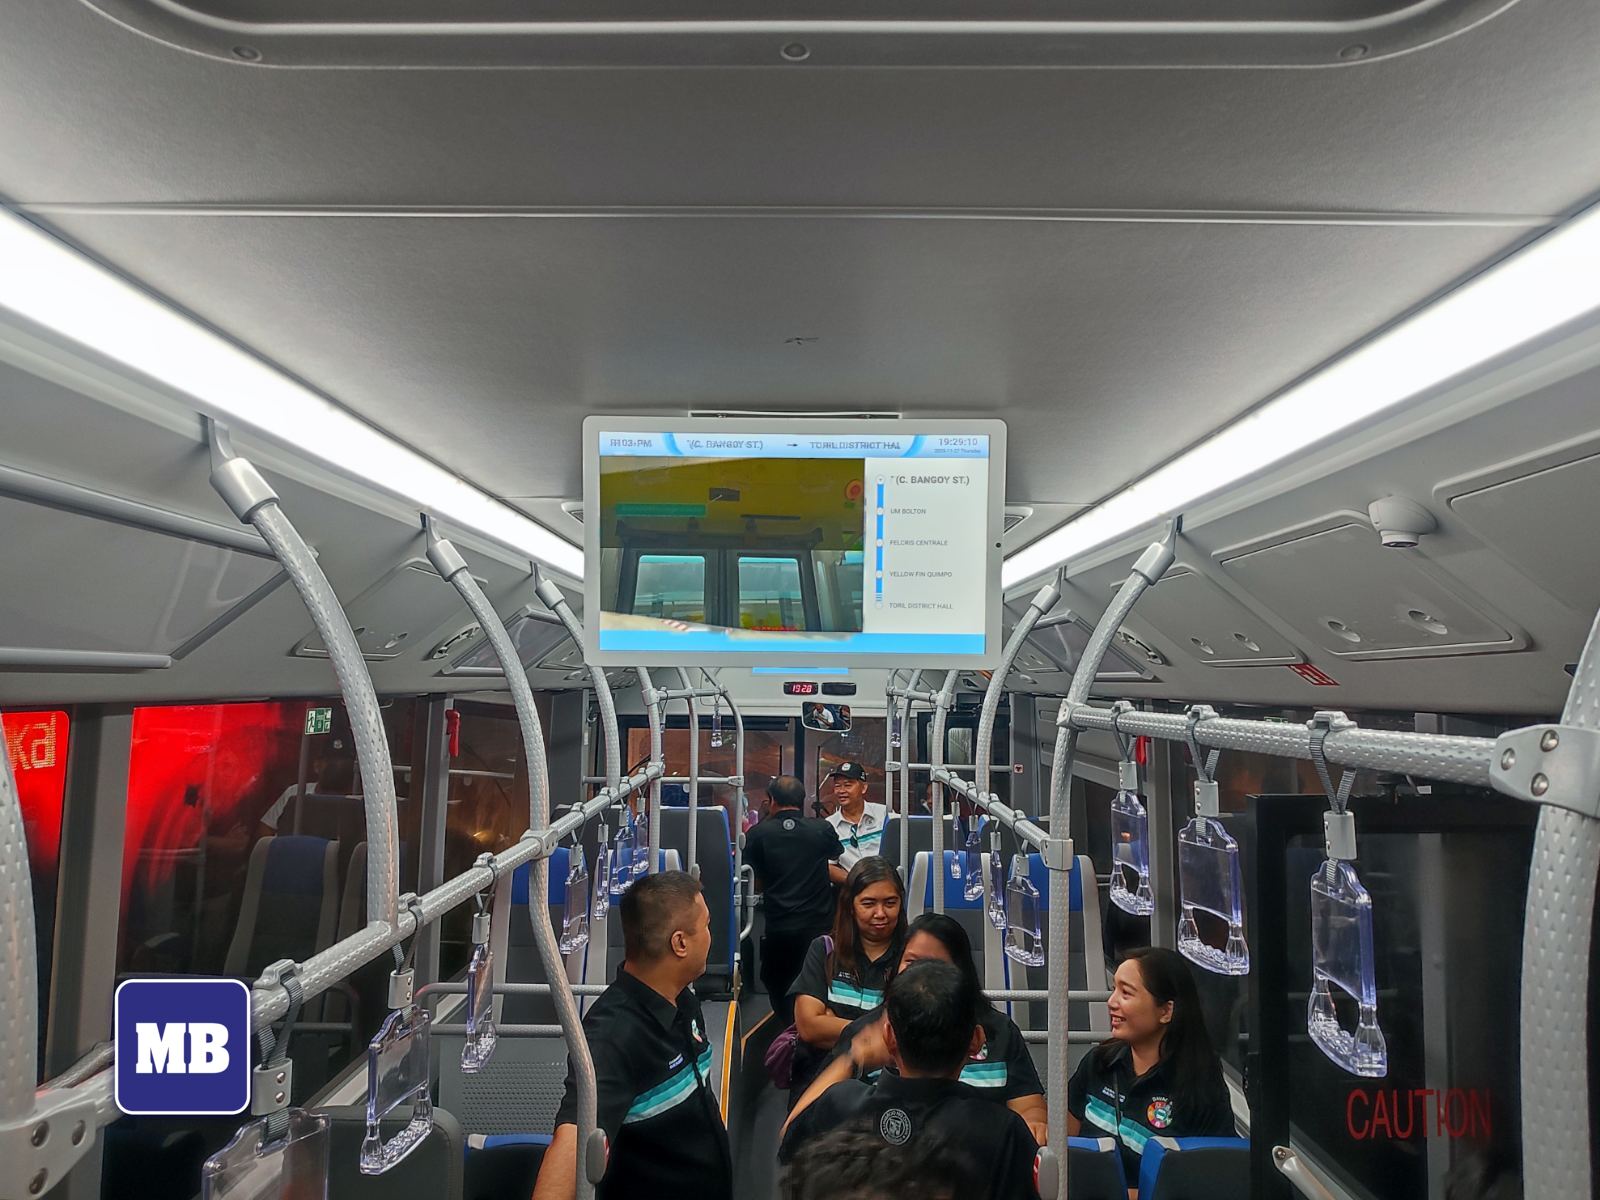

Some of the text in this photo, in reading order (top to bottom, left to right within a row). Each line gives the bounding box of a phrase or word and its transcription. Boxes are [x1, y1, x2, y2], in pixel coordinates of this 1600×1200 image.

[938, 437, 978, 447] 19:29:10
[910, 475, 950, 485] BANGOY
[952, 475, 970, 486] ST.)
[937, 602, 953, 610] HALL
[1345, 1088, 1493, 1141] CAUTION
